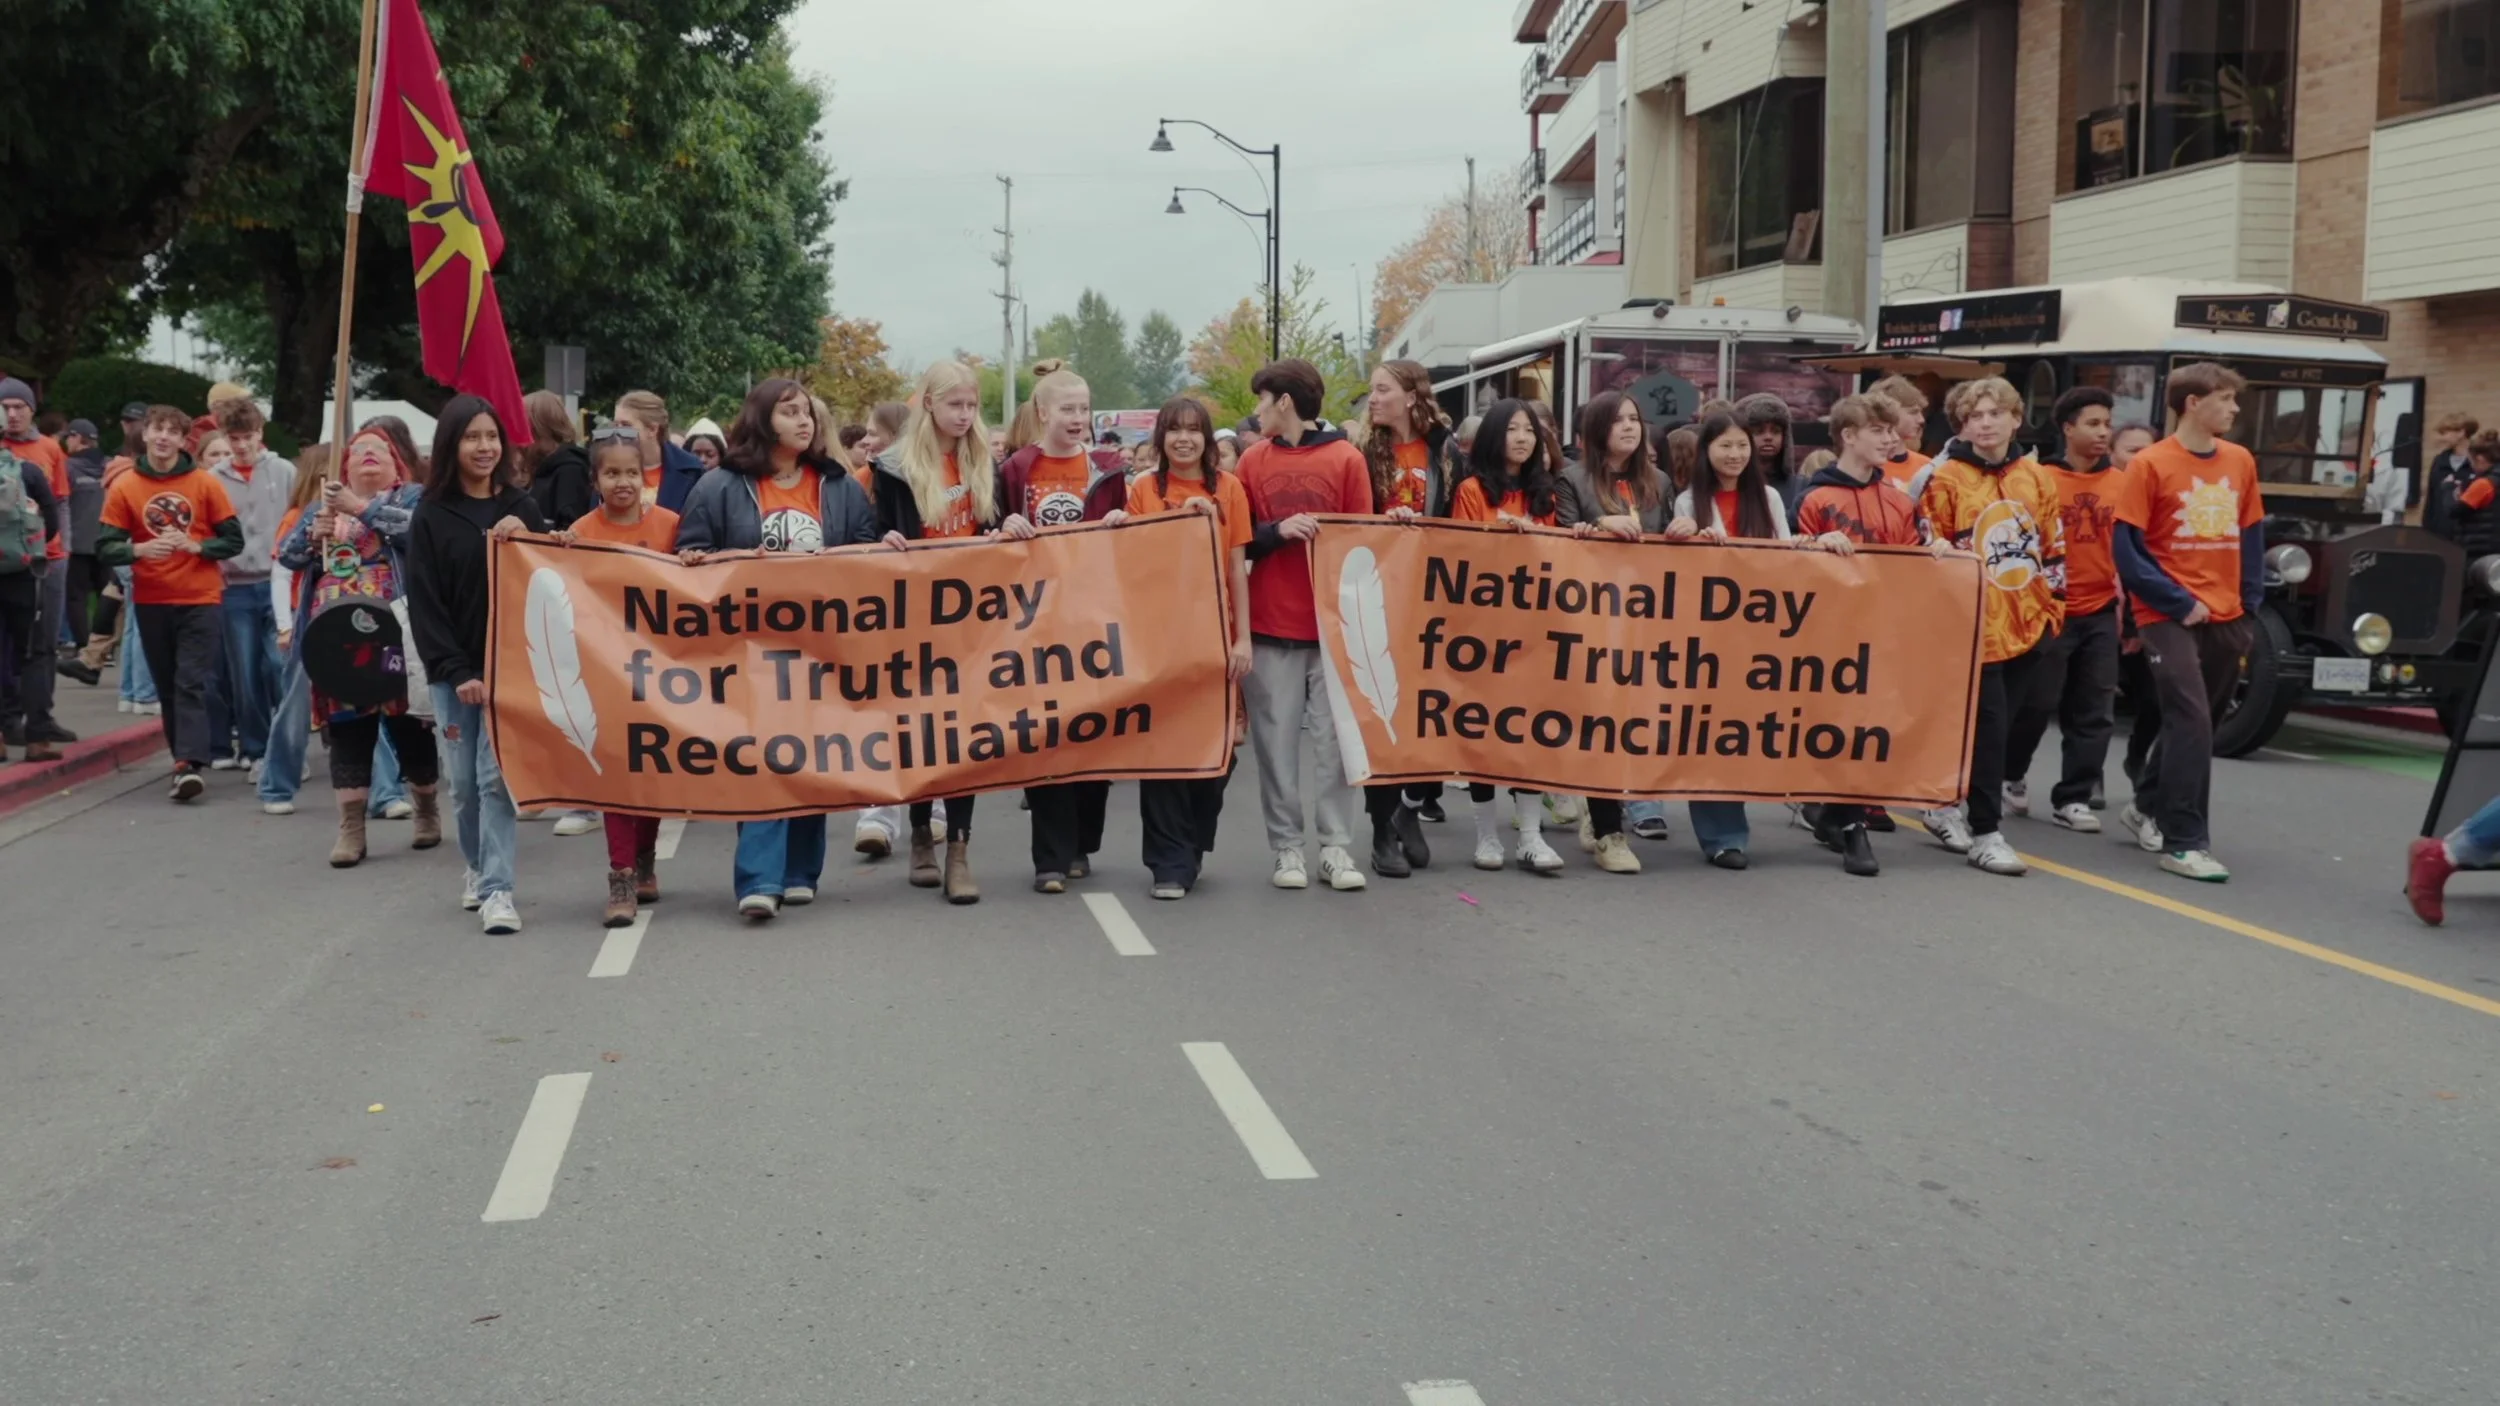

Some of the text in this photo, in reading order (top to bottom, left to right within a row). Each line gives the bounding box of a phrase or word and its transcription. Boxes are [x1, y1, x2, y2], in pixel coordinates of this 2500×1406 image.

[624, 578, 1046, 637] National Day
[1424, 556, 1816, 638] National Day
[624, 622, 1125, 704] for Truth and
[1419, 617, 1870, 694] for Truth and
[627, 700, 1152, 776] Reconciliation
[1416, 689, 1891, 763] Reconciliation
